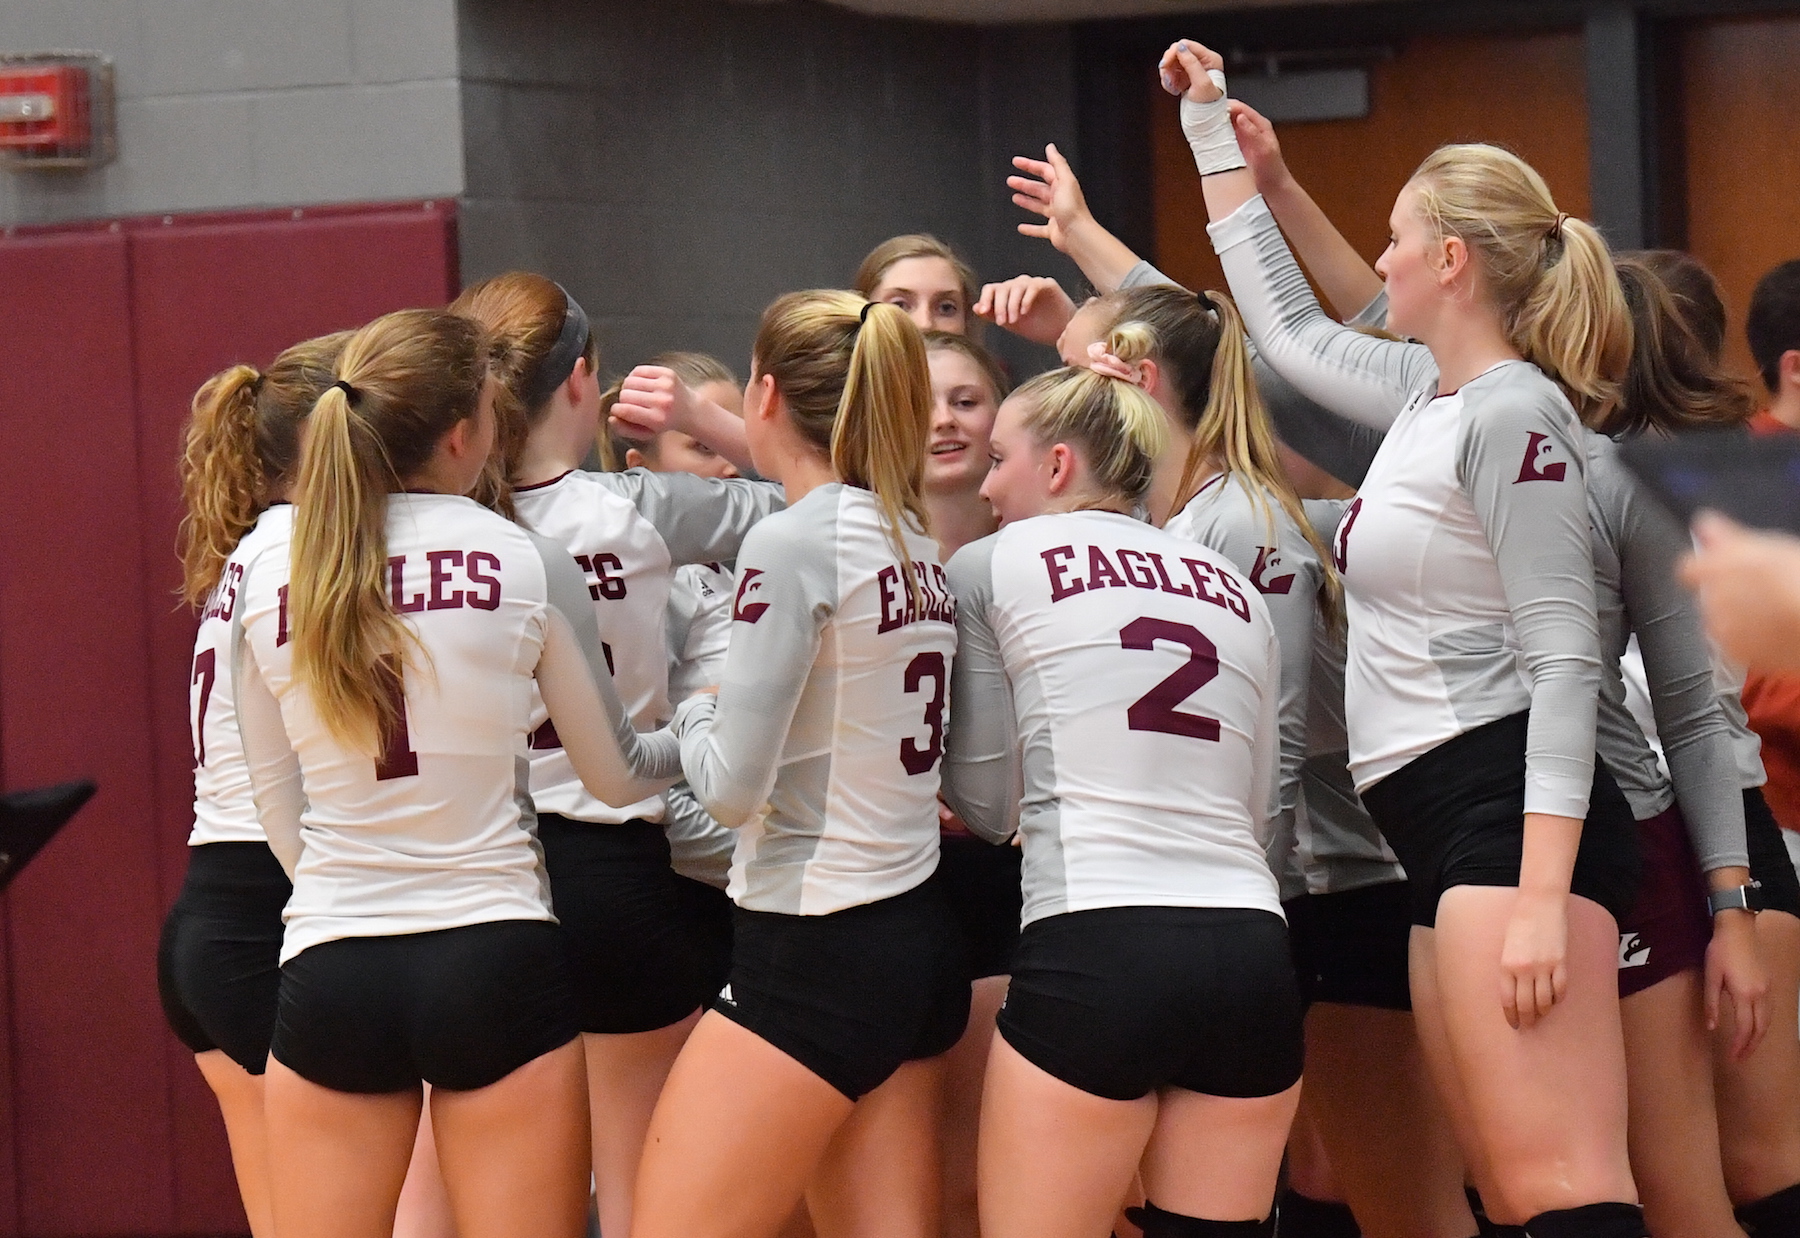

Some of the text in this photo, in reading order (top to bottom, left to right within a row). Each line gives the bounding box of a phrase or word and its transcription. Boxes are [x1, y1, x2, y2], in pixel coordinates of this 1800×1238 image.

[1040, 545, 1251, 623] EAGLES
[193, 647, 216, 767] 7
[369, 652, 418, 781] 1
[900, 652, 946, 776] 3
[1119, 616, 1221, 742] 2
